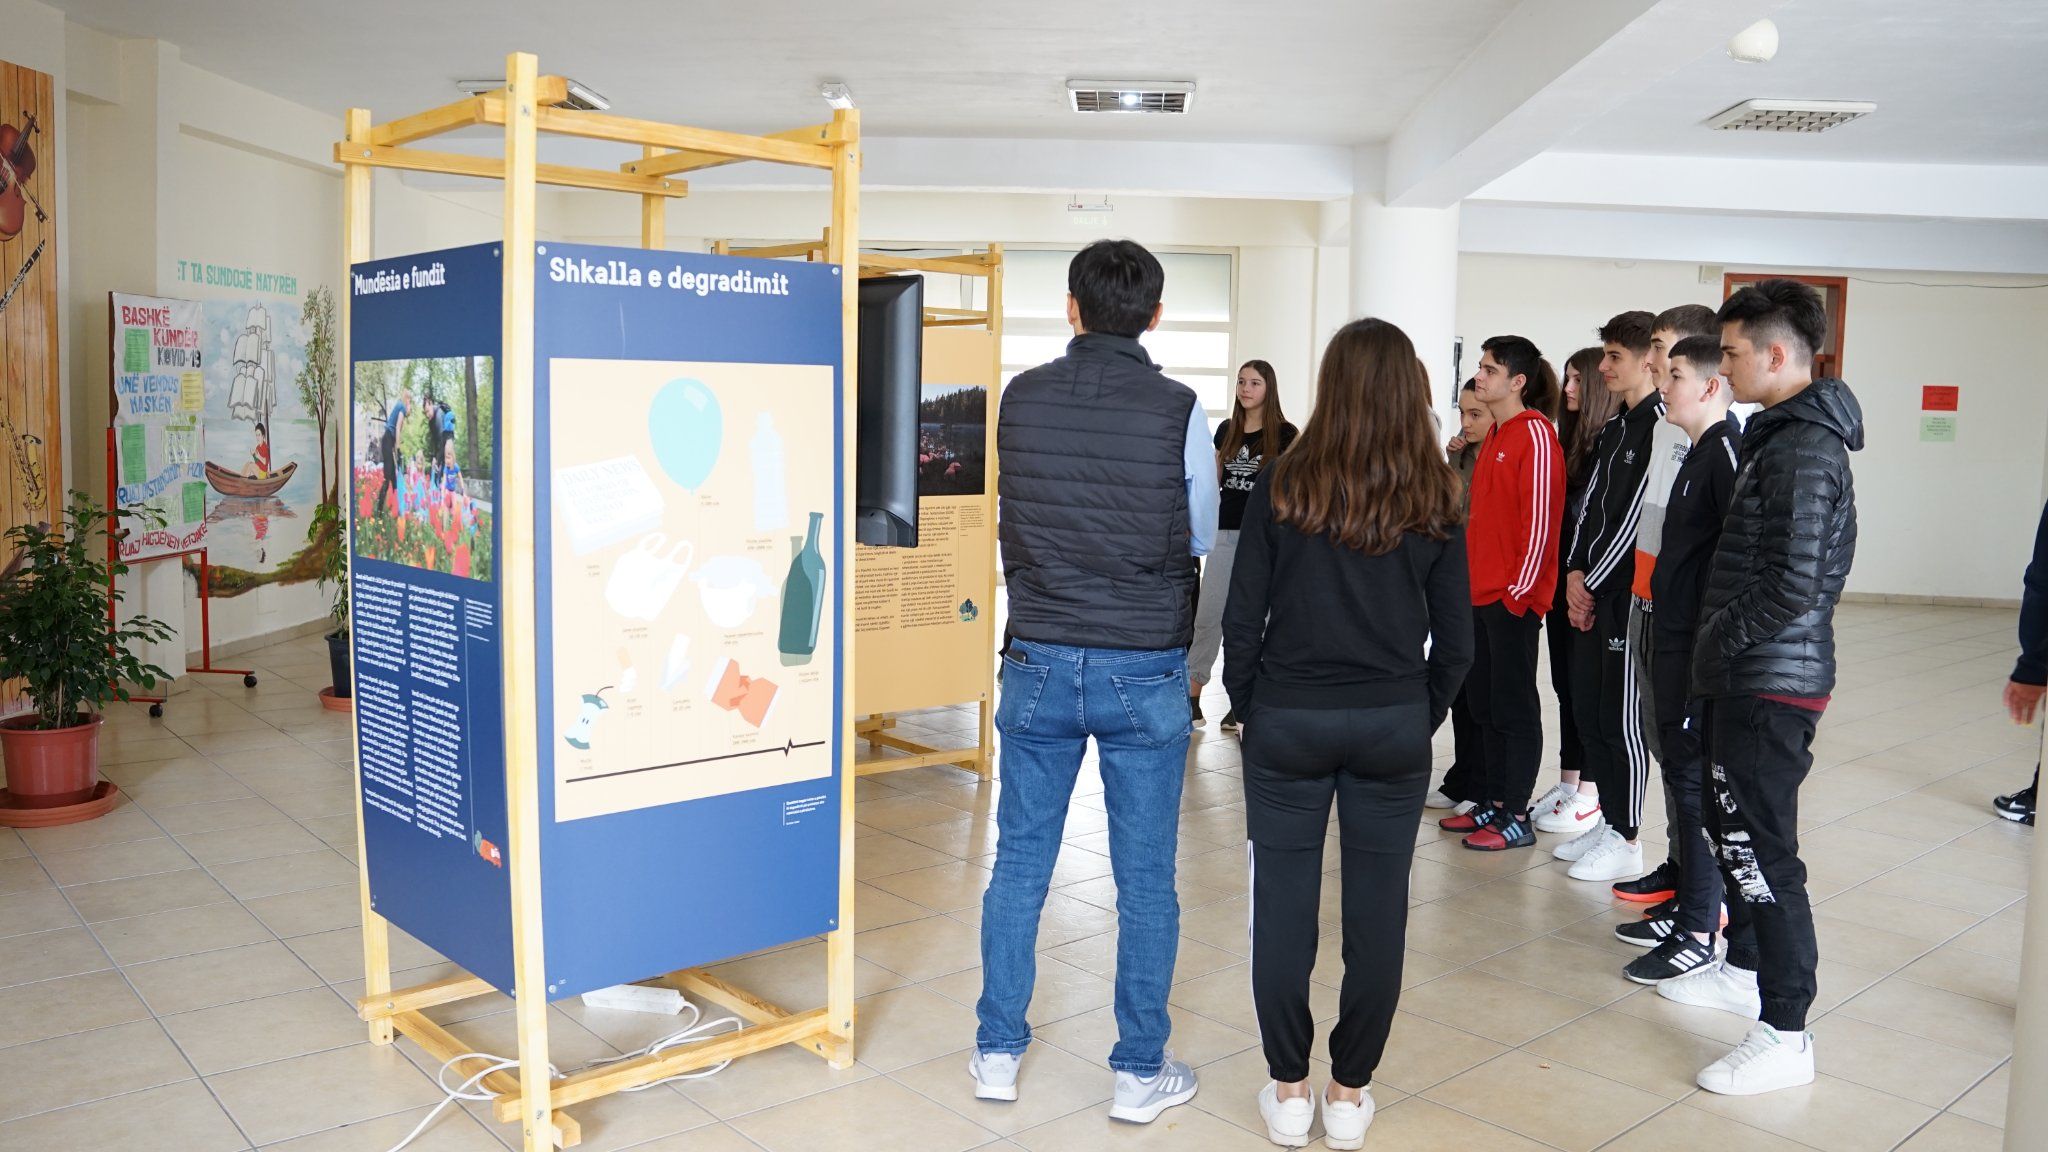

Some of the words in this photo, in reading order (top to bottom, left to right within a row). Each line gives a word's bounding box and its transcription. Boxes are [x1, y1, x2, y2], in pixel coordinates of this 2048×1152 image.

[191, 262, 203, 283] TA
[354, 269, 401, 296] Mundësia
[402, 273, 411, 290] e
[411, 262, 446, 288] fundit
[549, 256, 642, 287] Shkalla
[647, 269, 663, 288] e
[667, 265, 789, 297] degradimit
[121, 305, 170, 328] BASHKË
[153, 326, 198, 348] KUNDËR
[118, 372, 139, 395] UNË
[143, 374, 178, 394] VENDOS
[119, 540, 141, 557] RUAJ
